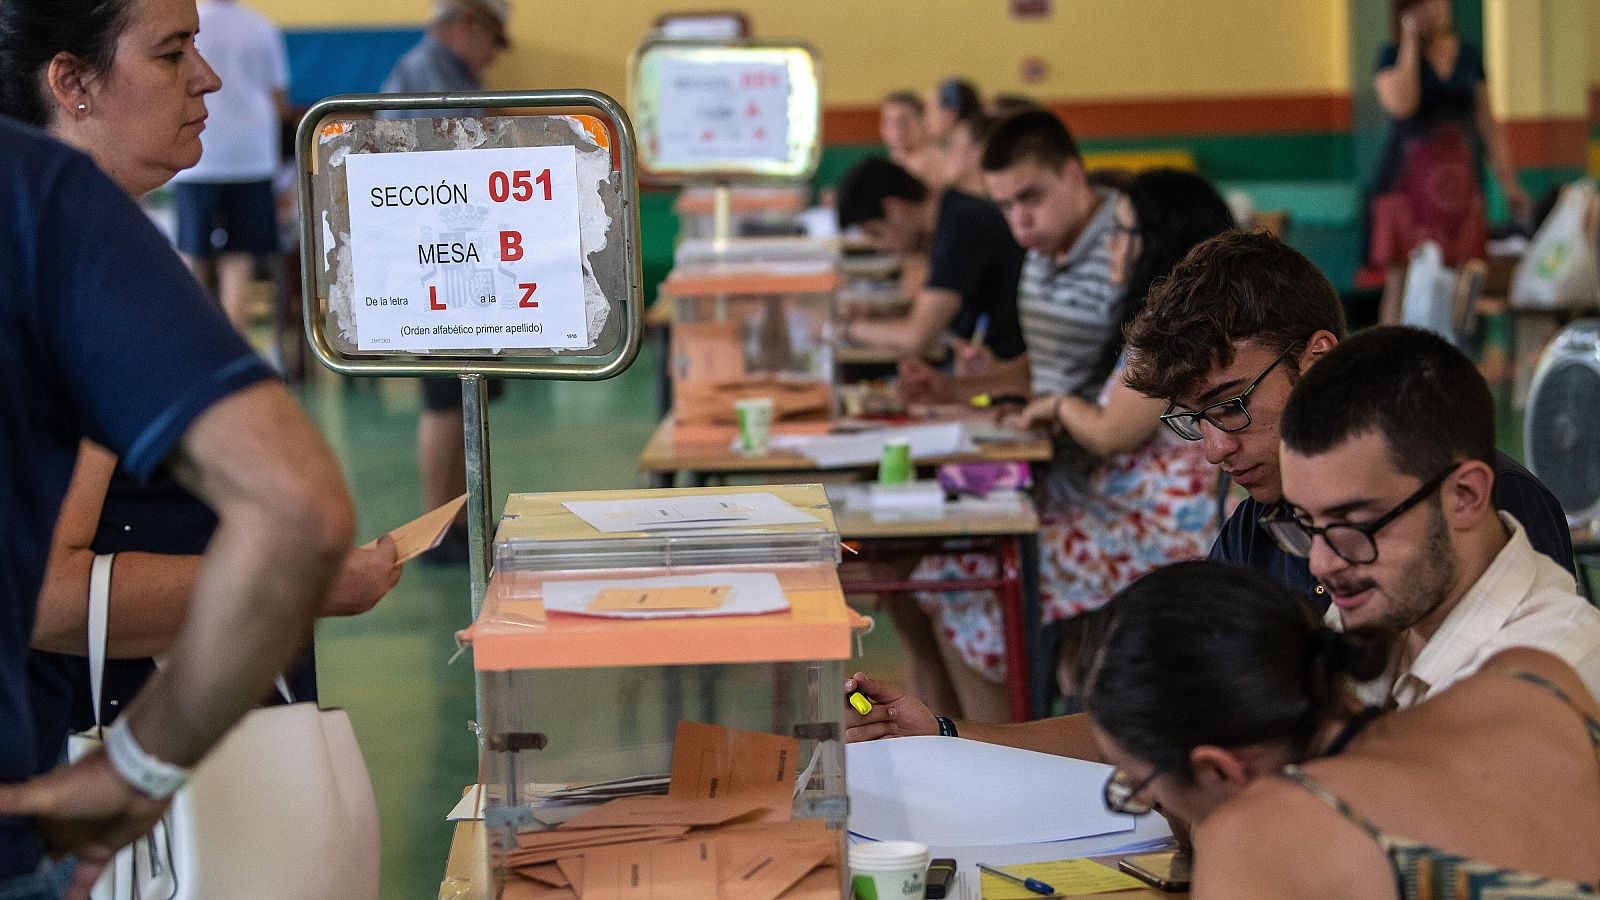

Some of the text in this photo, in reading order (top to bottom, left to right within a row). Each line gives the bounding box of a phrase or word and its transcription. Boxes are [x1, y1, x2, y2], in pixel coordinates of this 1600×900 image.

[370, 168, 553, 207] SECCIÓN 051
[418, 230, 524, 264] MESA B
[365, 296, 378, 306] De
[380, 296, 388, 306] la
[390, 296, 409, 306] letra
[429, 285, 447, 311] L
[488, 294, 497, 303] la
[518, 282, 539, 308] Z
[400, 323, 543, 337] (Orden alfabético primer apellido)
